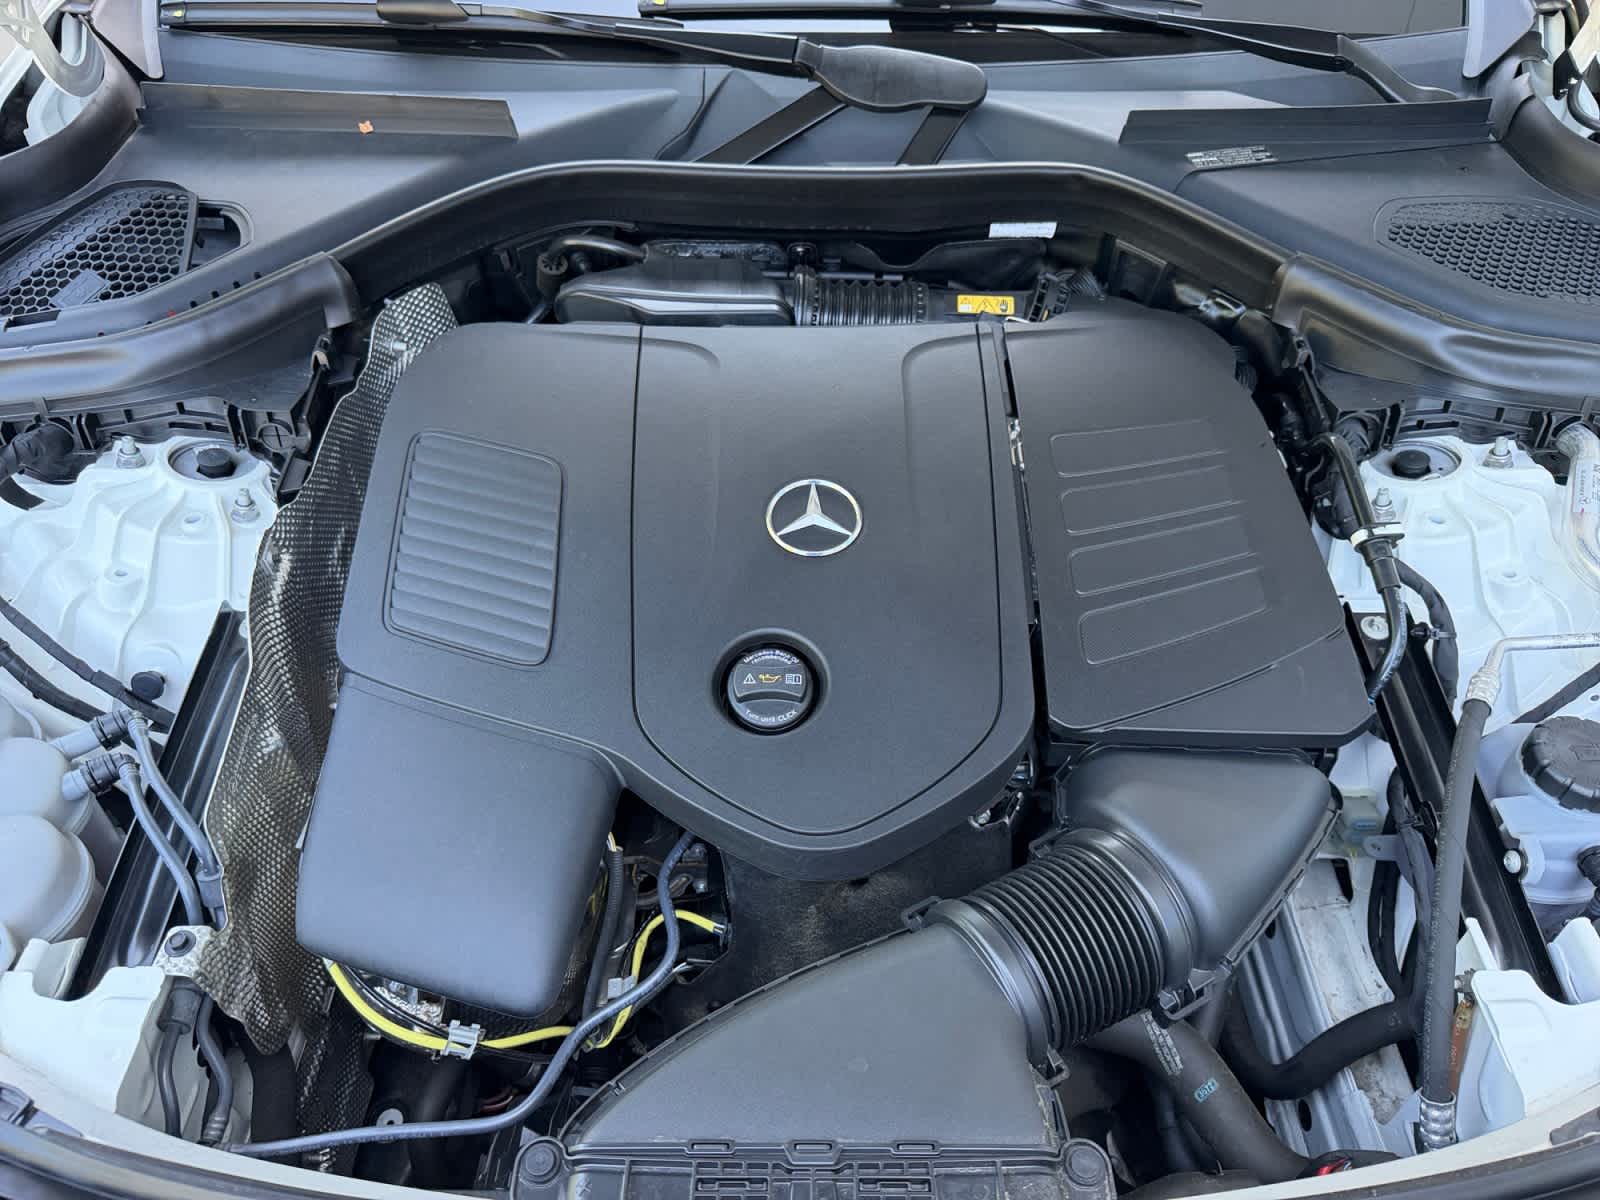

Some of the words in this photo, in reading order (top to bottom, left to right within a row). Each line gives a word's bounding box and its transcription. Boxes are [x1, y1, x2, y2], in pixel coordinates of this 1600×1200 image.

[746, 709, 759, 721] Turn
[760, 714, 776, 722] until
[778, 709, 797, 722] CLICK
